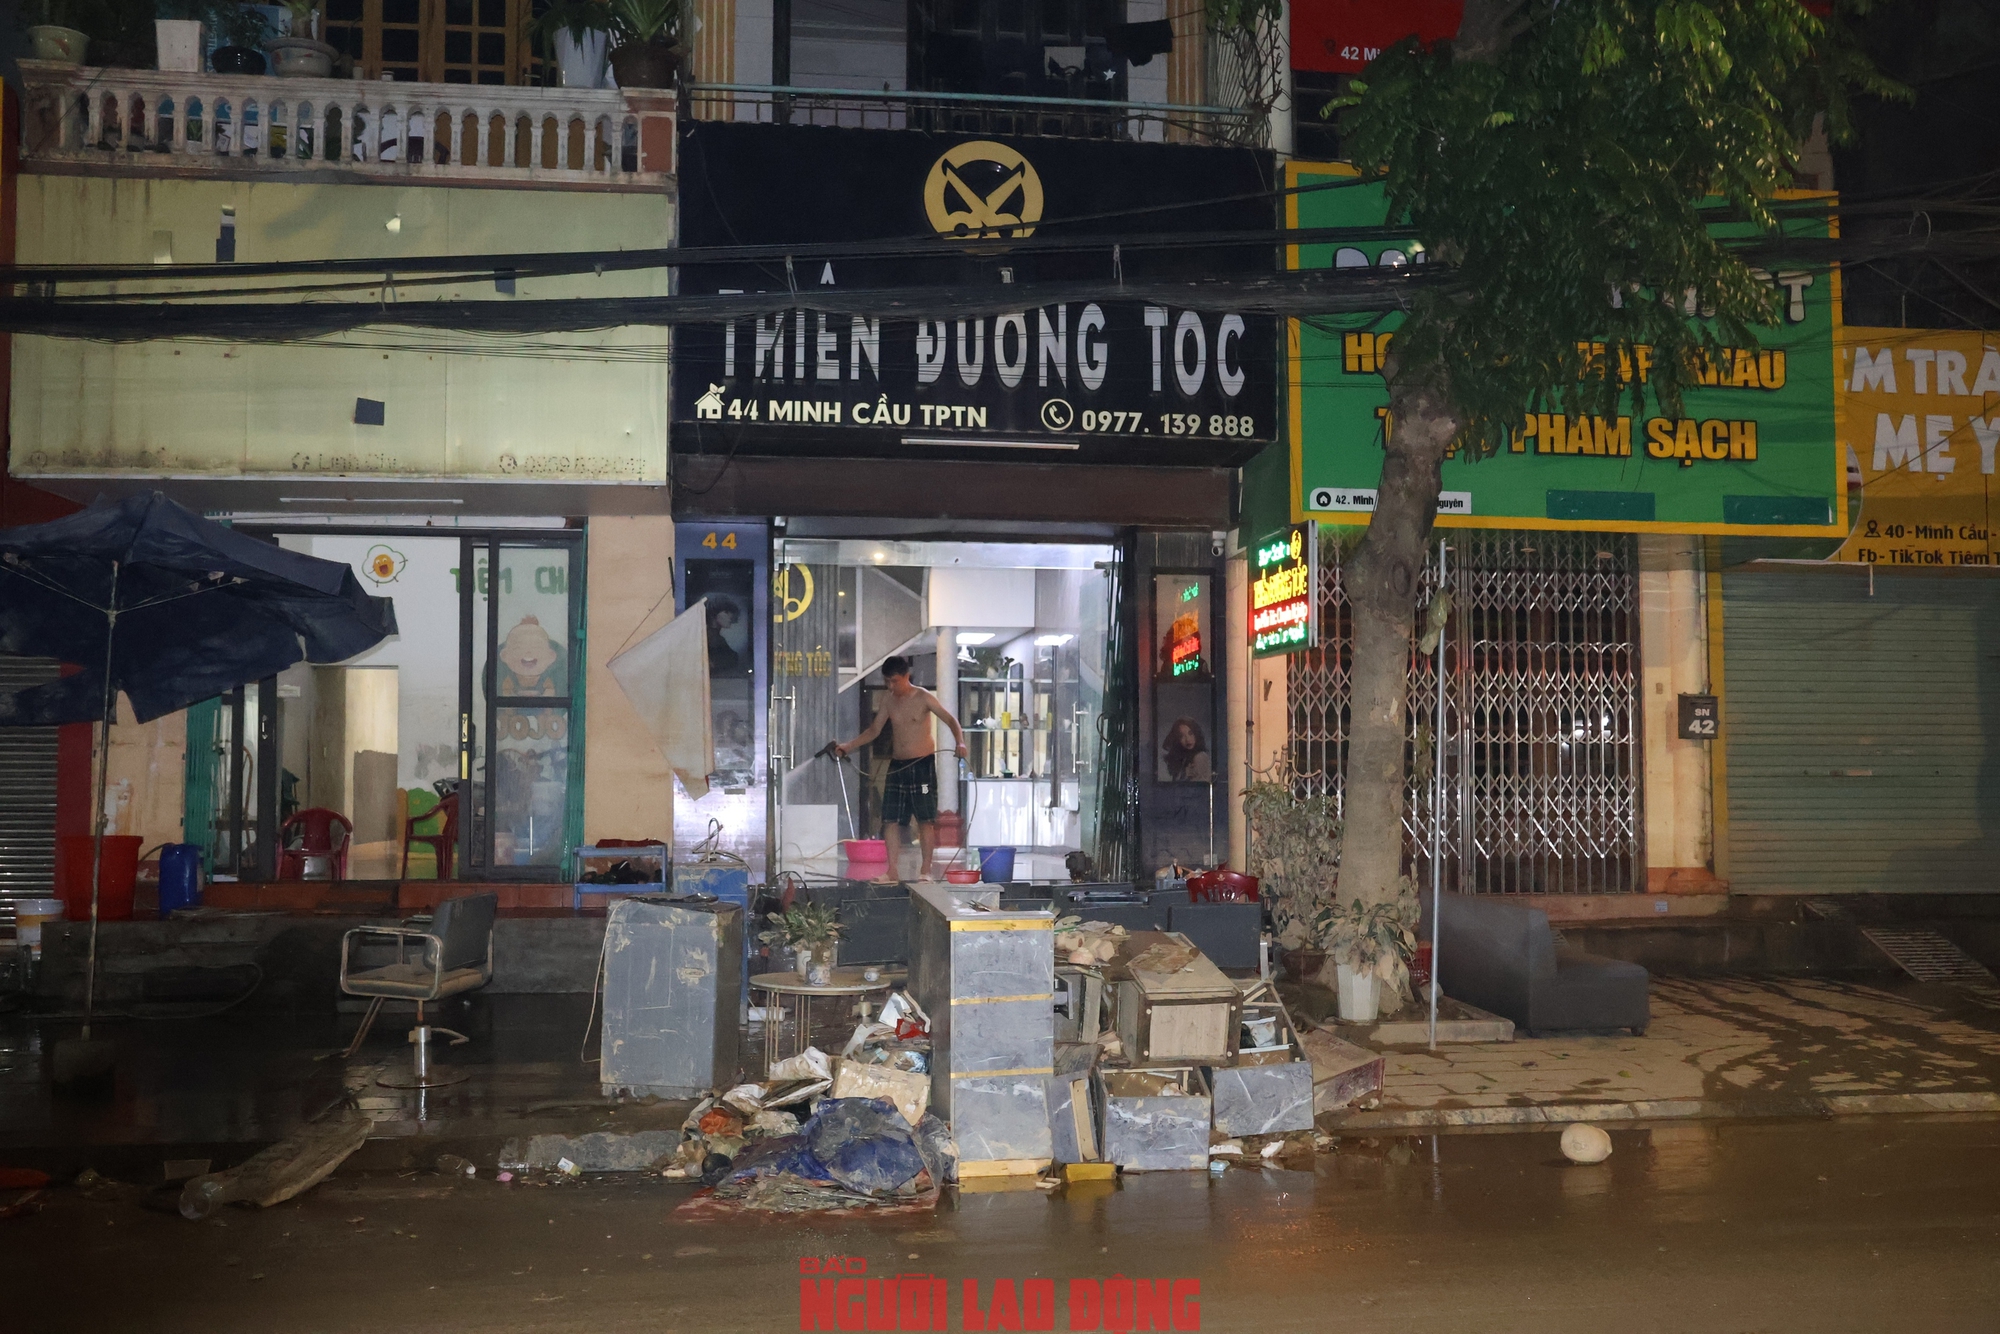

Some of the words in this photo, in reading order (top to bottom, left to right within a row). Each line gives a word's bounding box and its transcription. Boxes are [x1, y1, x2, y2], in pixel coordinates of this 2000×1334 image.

[1341, 47, 1359, 60] 42
[728, 399, 759, 420] 44
[769, 400, 841, 423] MINH
[852, 393, 911, 425] CẦU
[920, 404, 987, 427] TPTN
[1082, 409, 1150, 434] 0977.
[1160, 413, 1201, 435] 139
[1209, 415, 1255, 437] 888
[1647, 417, 1757, 466] SẠCH
[1872, 412, 1956, 481] MẸ
[1353, 495, 1374, 505] Minh
[702, 532, 737, 550] 44
[535, 566, 568, 595] CH
[1694, 708, 1710, 716] SN
[1688, 719, 1715, 734] 42
